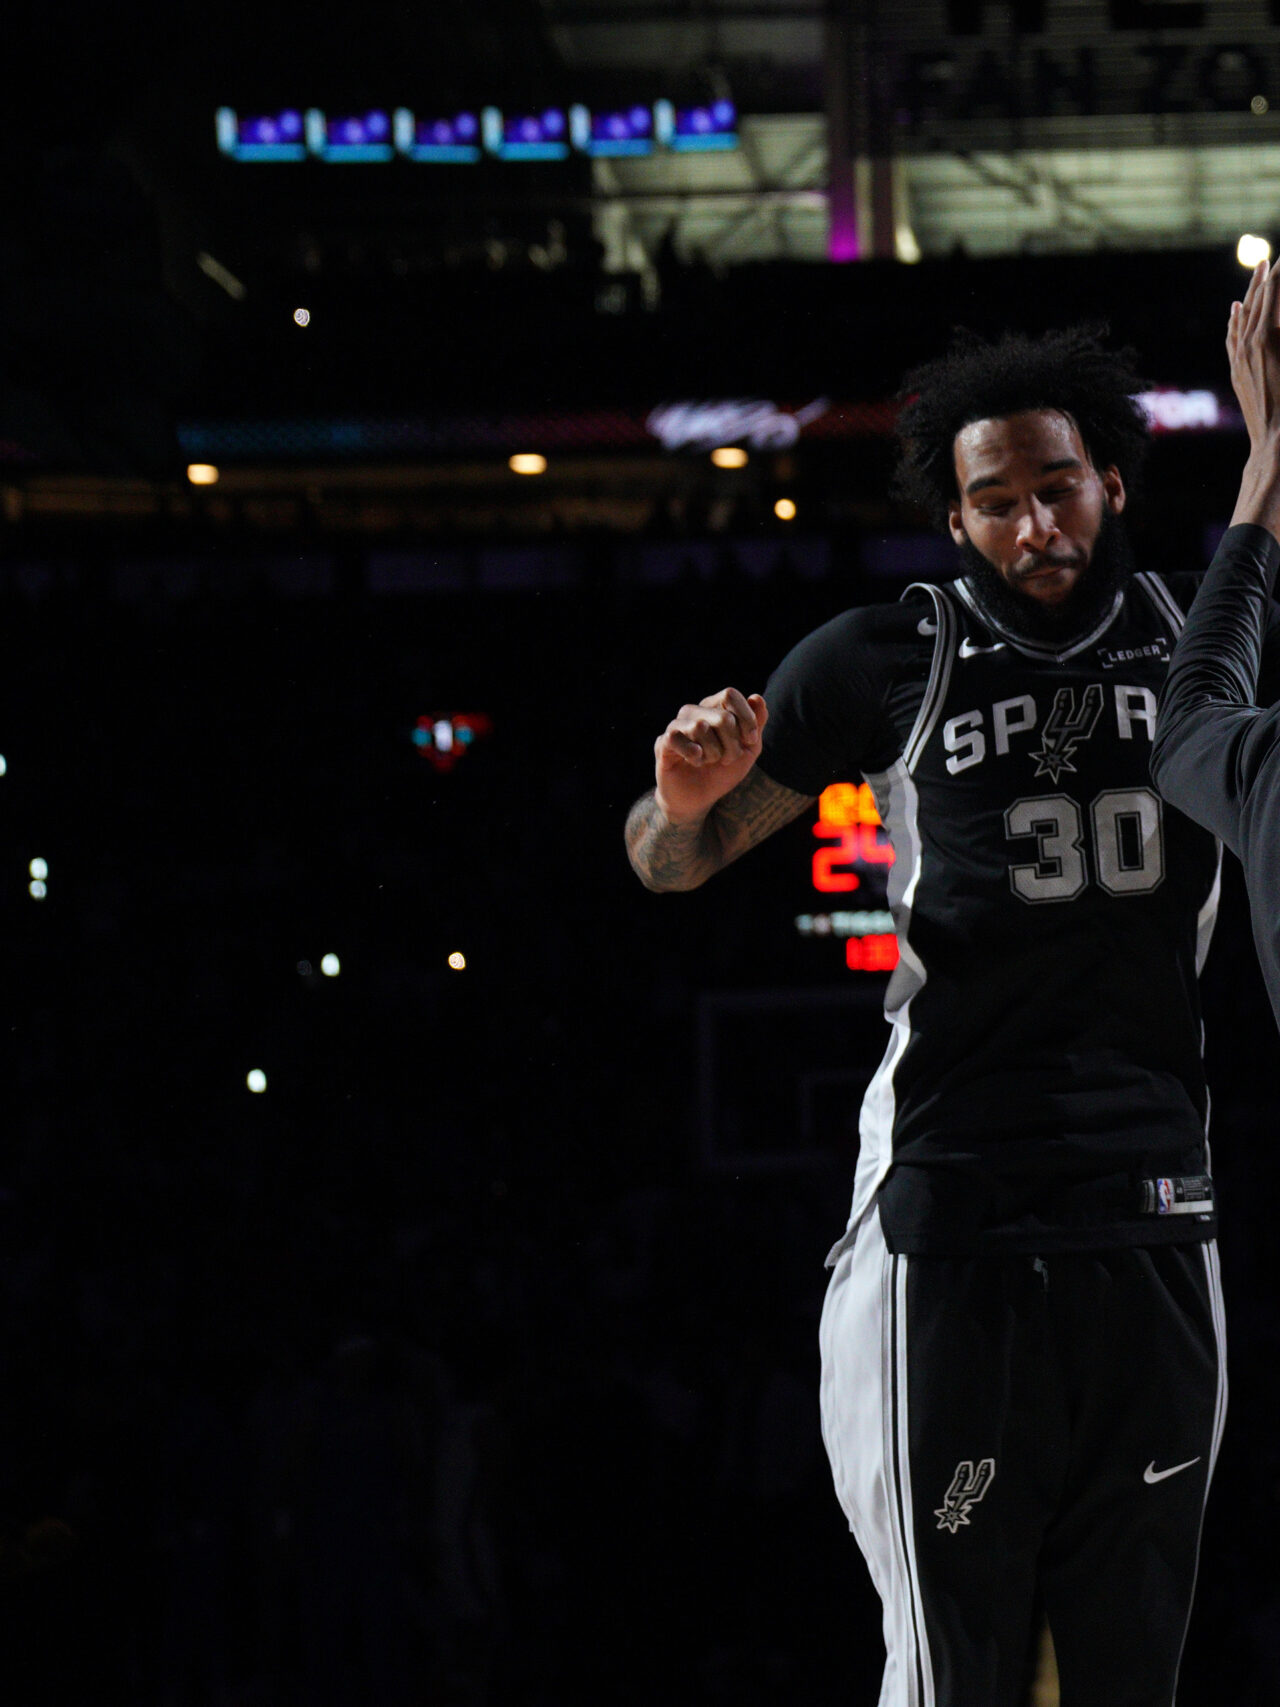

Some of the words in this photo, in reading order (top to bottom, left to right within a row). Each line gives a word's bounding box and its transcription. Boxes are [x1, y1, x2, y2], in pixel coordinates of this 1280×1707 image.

[902, 46, 1095, 117] FAN
[1107, 643, 1161, 662] LEDGER
[943, 682, 1158, 784] SPUR
[1003, 786, 1166, 905] 30
